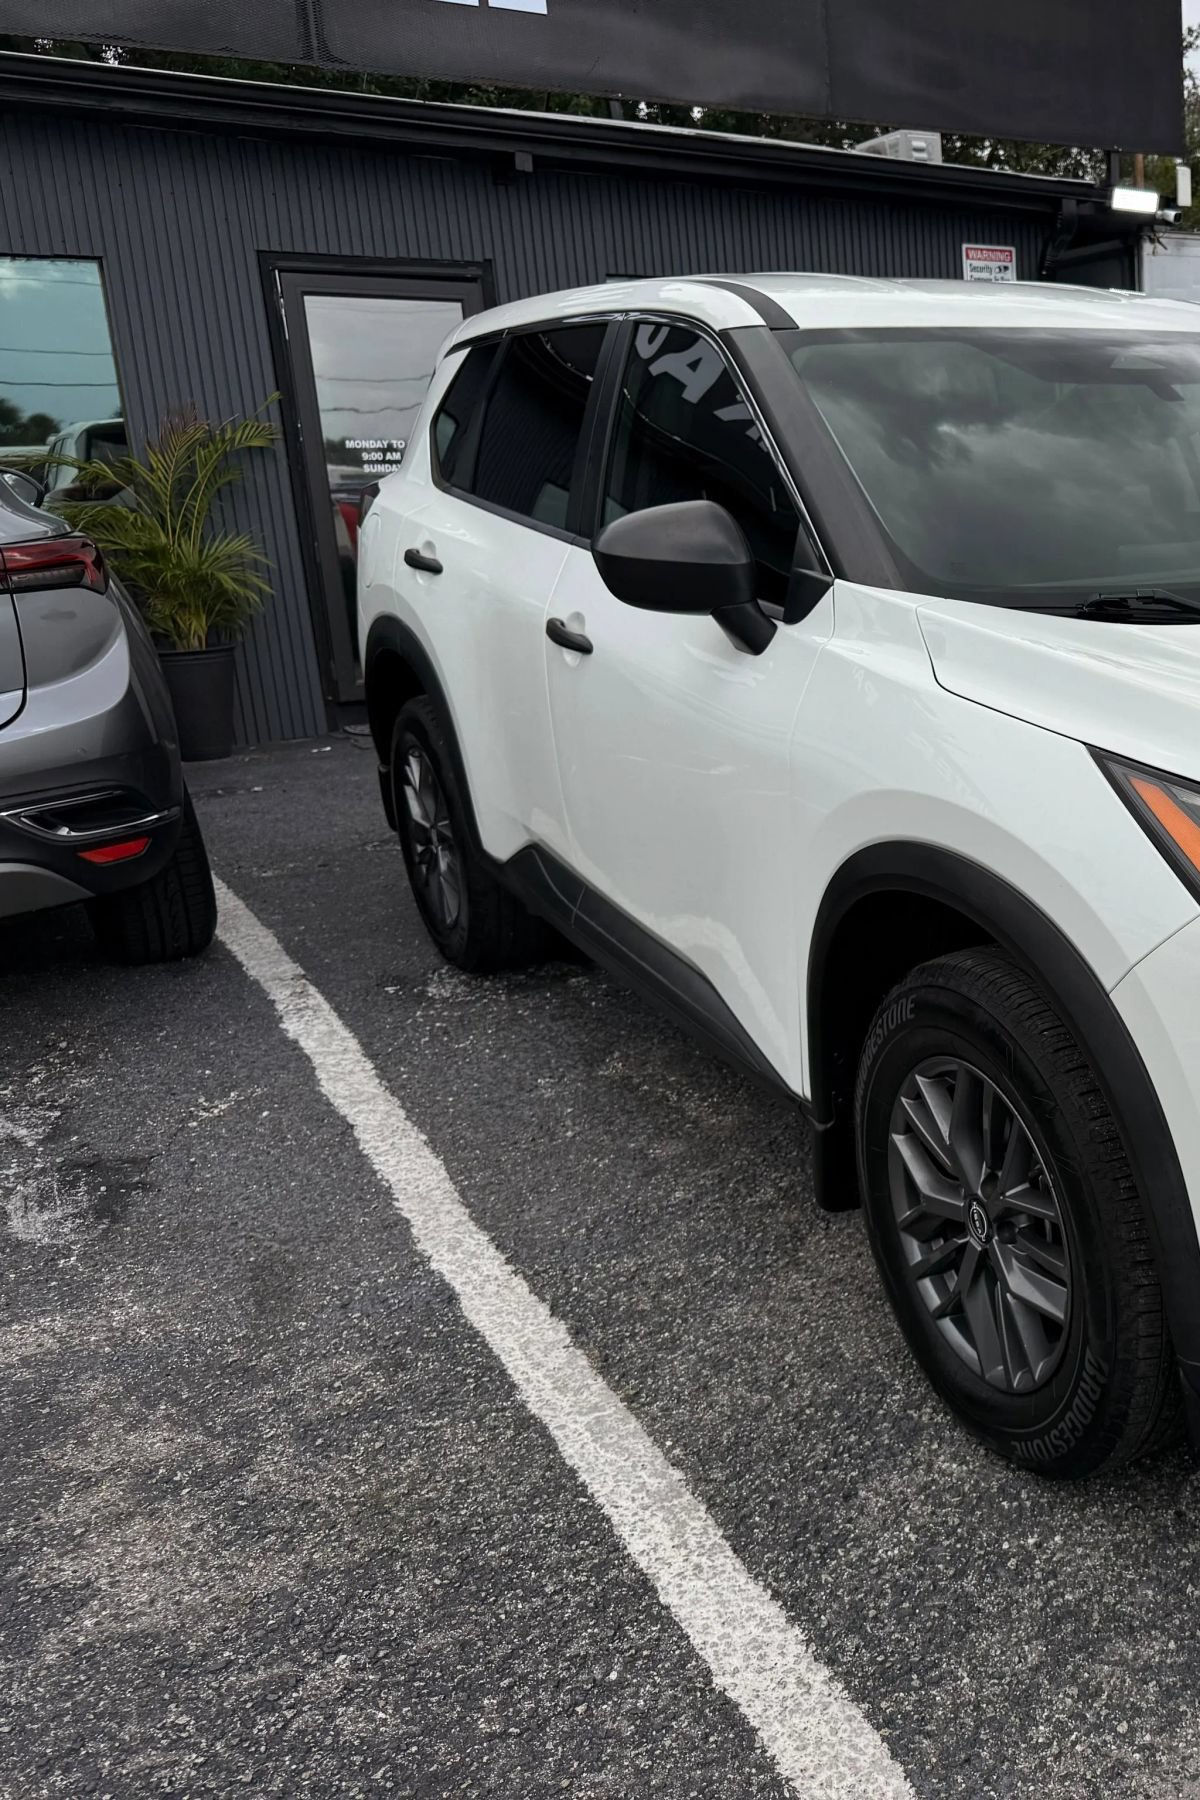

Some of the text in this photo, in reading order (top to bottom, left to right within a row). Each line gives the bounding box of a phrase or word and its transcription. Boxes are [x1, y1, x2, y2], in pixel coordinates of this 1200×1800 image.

[967, 249, 1011, 262] WARNING
[969, 263, 992, 275] Security
[345, 440, 405, 448] MONDAY TO
[361, 452, 401, 460] 9:00 AM
[1010, 1345, 1109, 1461] BRIDGESTONE
